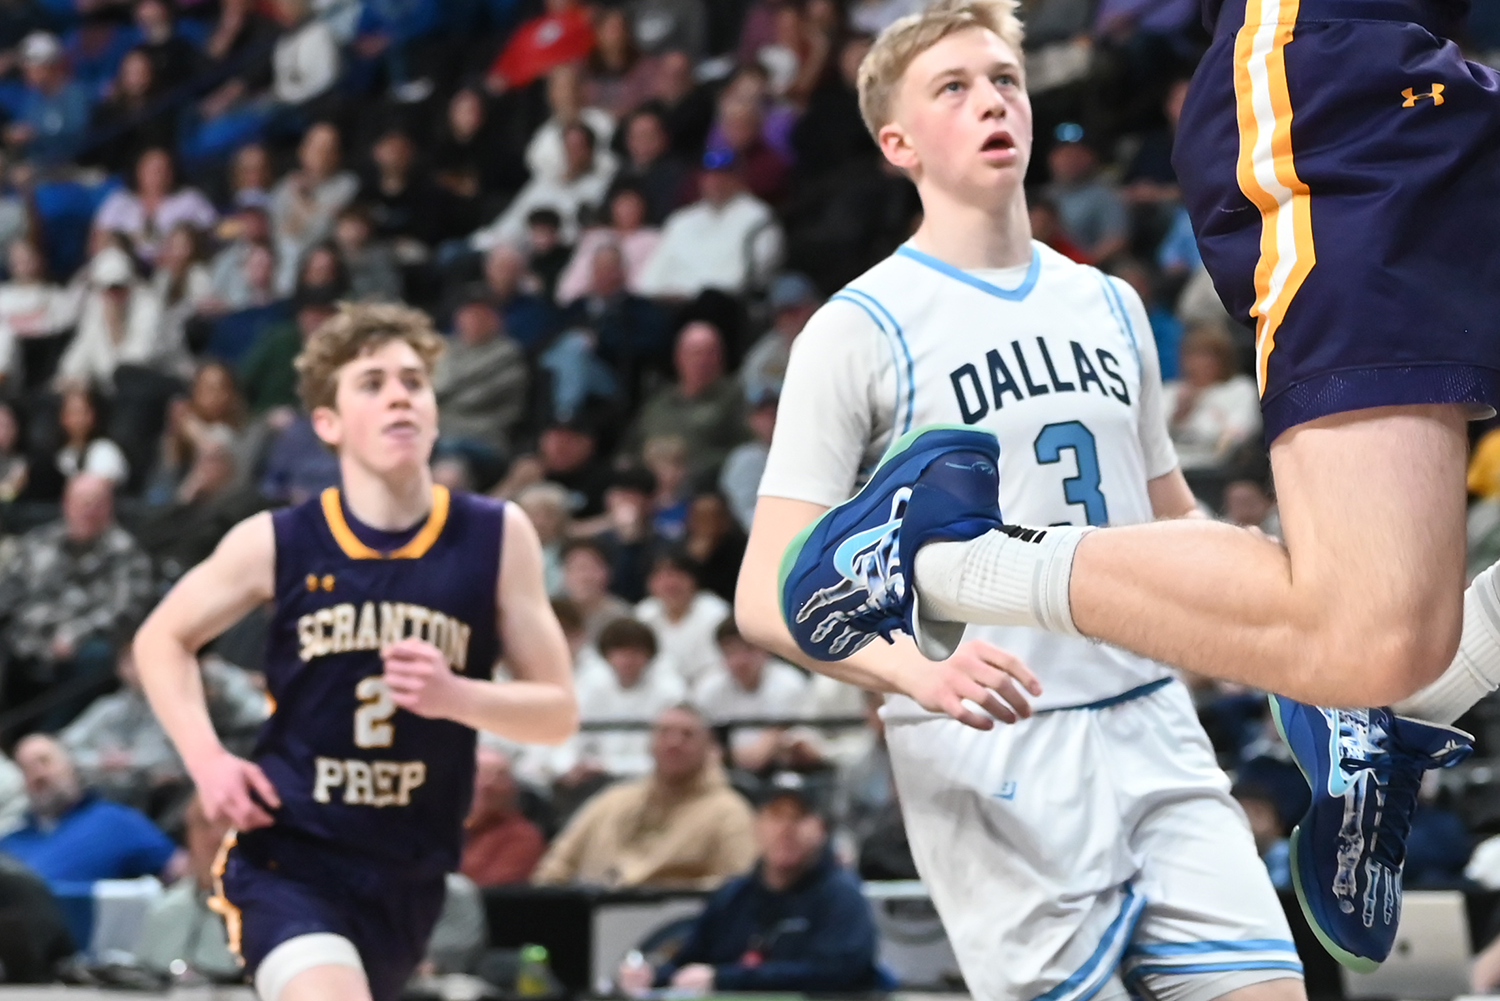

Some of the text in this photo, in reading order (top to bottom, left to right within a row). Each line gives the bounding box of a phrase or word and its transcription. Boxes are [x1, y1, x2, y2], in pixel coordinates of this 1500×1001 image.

[949, 336, 1131, 425] DALLAS
[1033, 419, 1109, 526] 3
[297, 601, 472, 672] SCRANTON
[353, 675, 400, 748] 2
[313, 756, 427, 807] PREP
